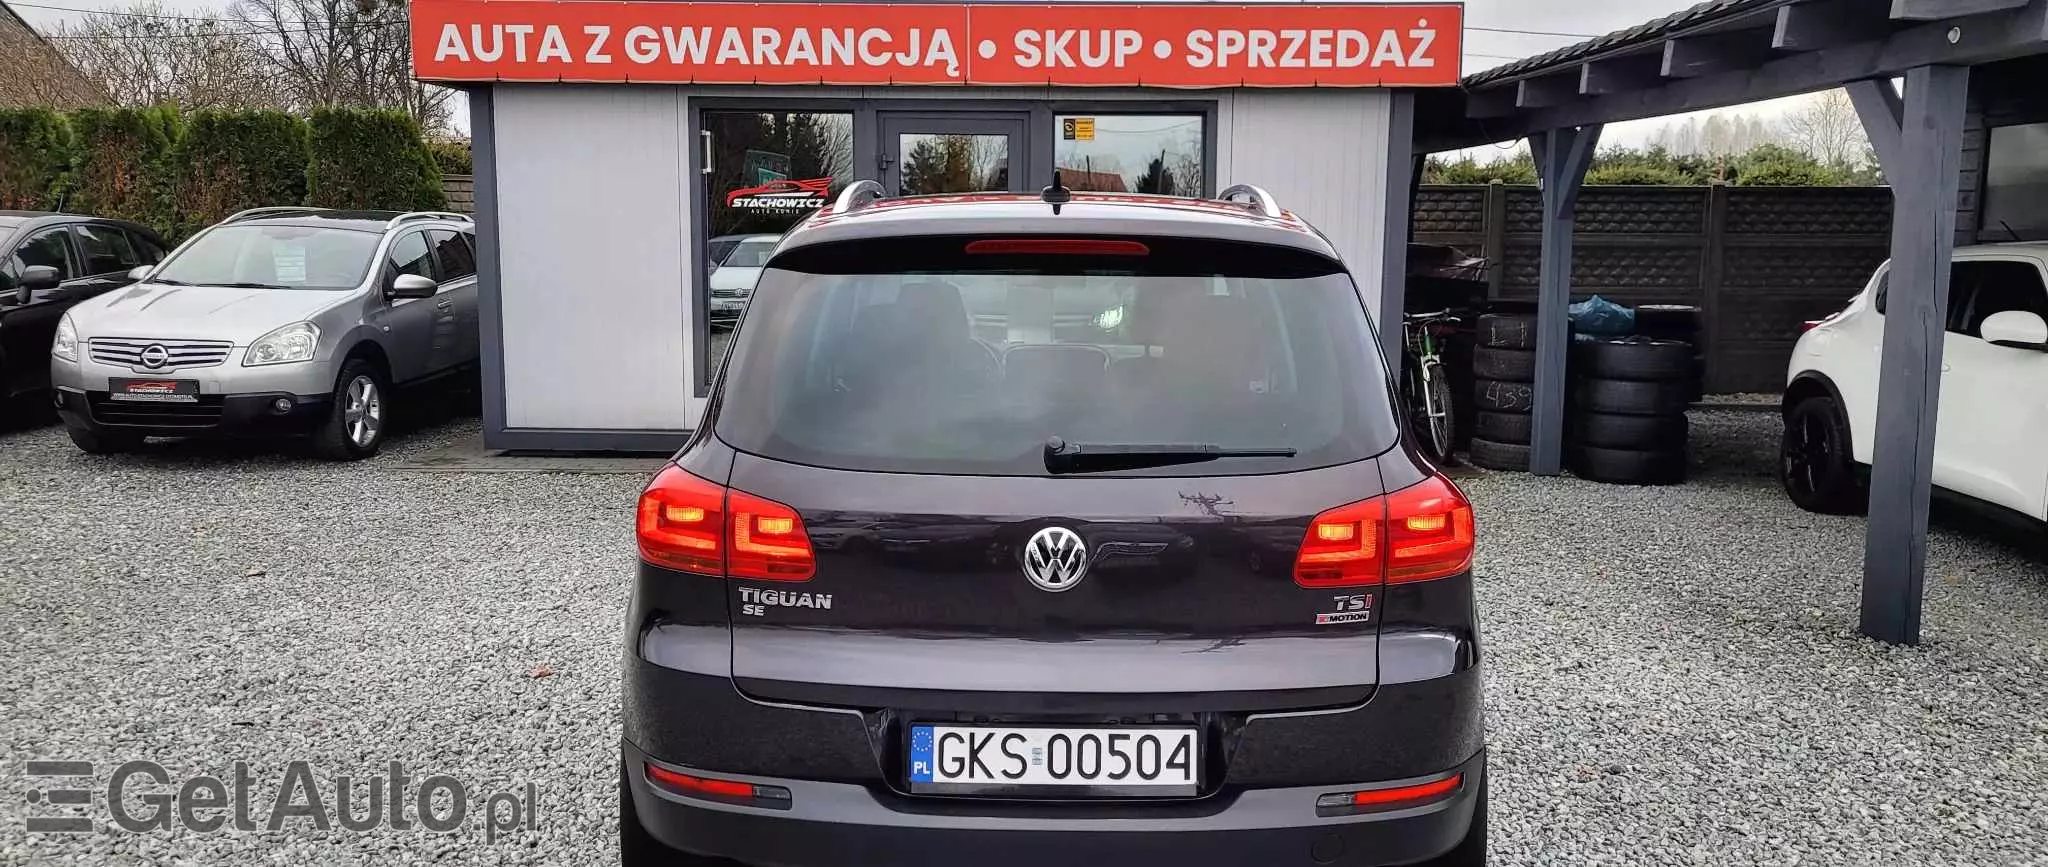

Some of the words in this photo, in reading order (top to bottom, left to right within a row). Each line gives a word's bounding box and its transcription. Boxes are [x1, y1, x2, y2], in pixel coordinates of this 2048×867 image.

[434, 23, 573, 63] AUTA
[583, 25, 612, 64] Z
[624, 26, 960, 77] GWARANCJĄ
[1013, 29, 1144, 68] SKUP
[1186, 18, 1436, 68] SPRZEDAŻ
[731, 198, 825, 208] STACHOWICZ
[738, 586, 833, 610] TIGUAN
[742, 603, 765, 616] SE
[937, 731, 1028, 779] GKS
[1047, 733, 1191, 781] 00504
[913, 761, 930, 775] PL
